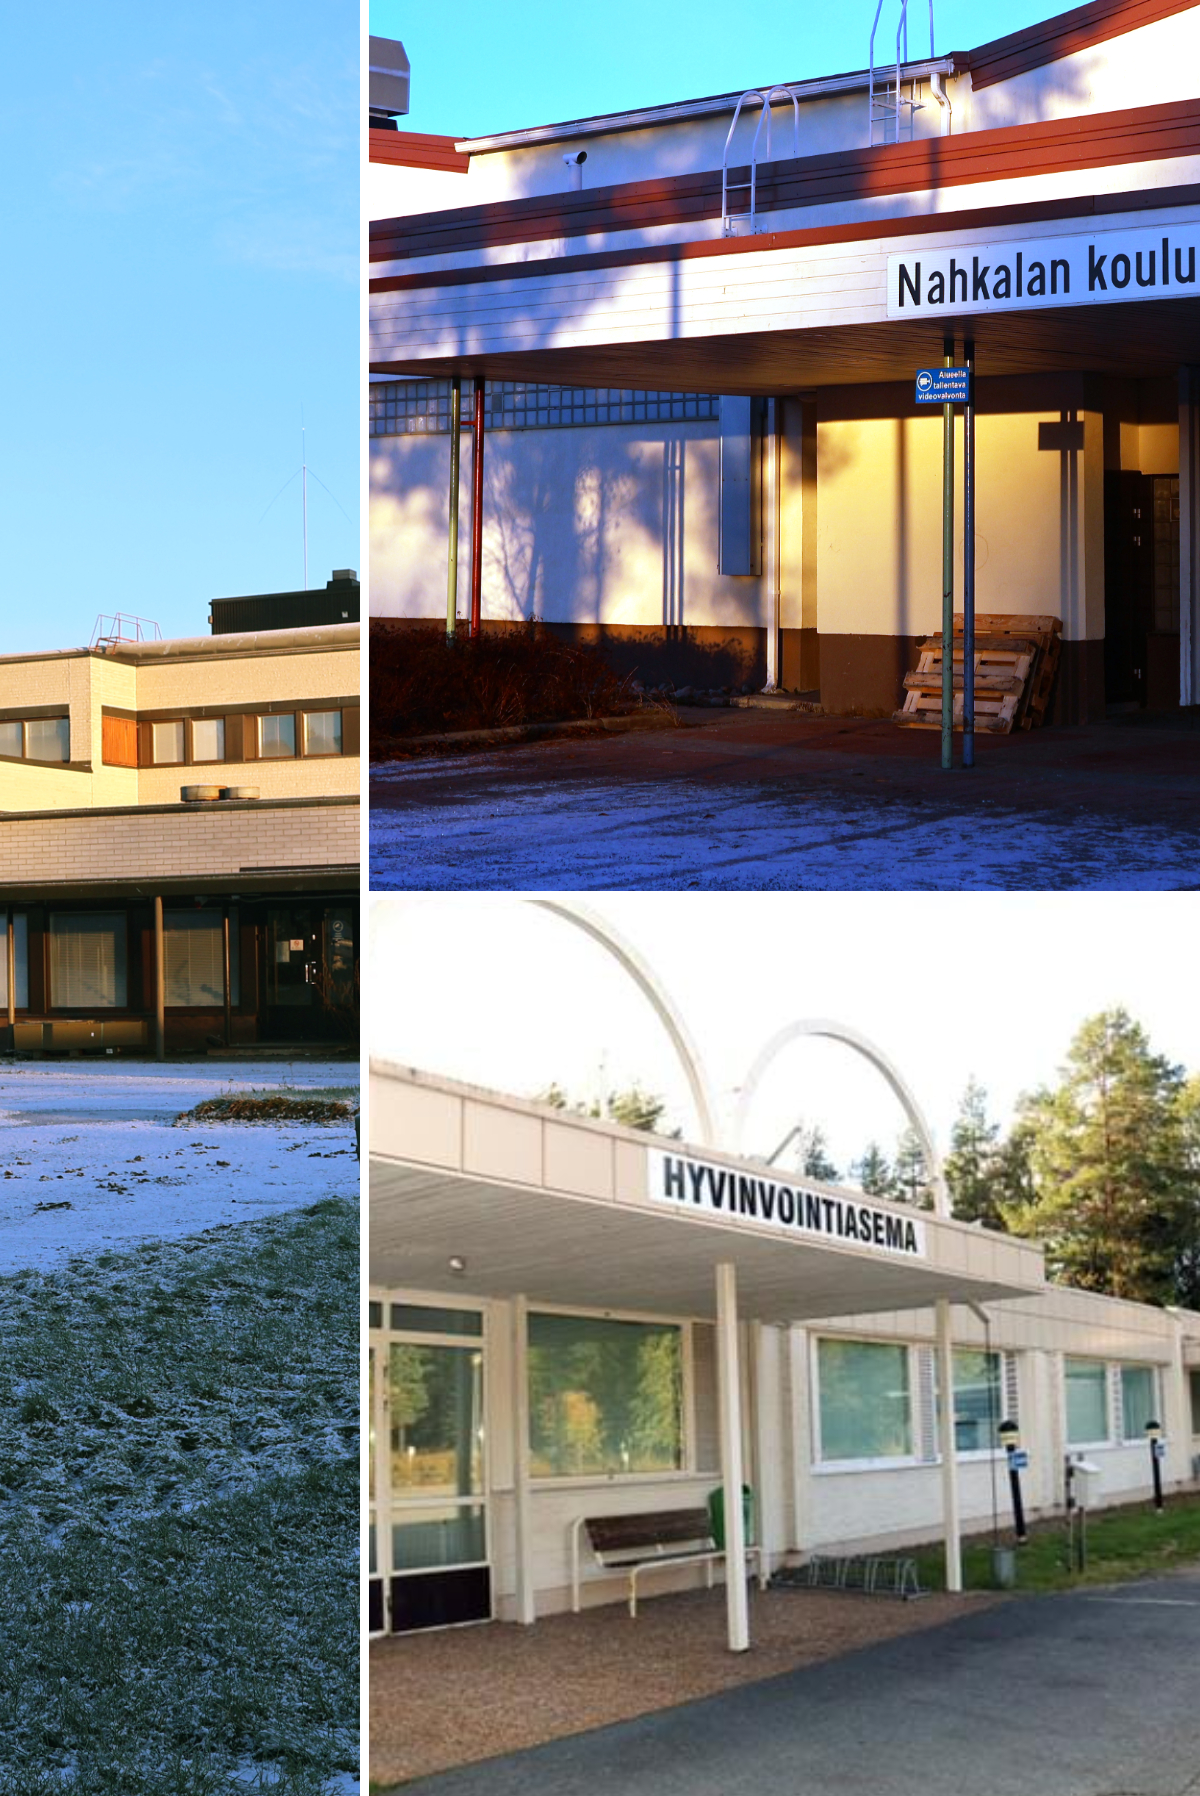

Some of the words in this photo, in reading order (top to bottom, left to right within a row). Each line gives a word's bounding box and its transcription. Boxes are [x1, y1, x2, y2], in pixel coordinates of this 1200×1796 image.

[898, 251, 1070, 307] Nahkalan
[1088, 237, 1196, 292] koulu
[938, 370, 967, 379] Alueella
[933, 381, 966, 390] tallentava
[918, 391, 966, 400] videovalvonta
[663, 1156, 918, 1253] HYVINVOINTIASEMA
